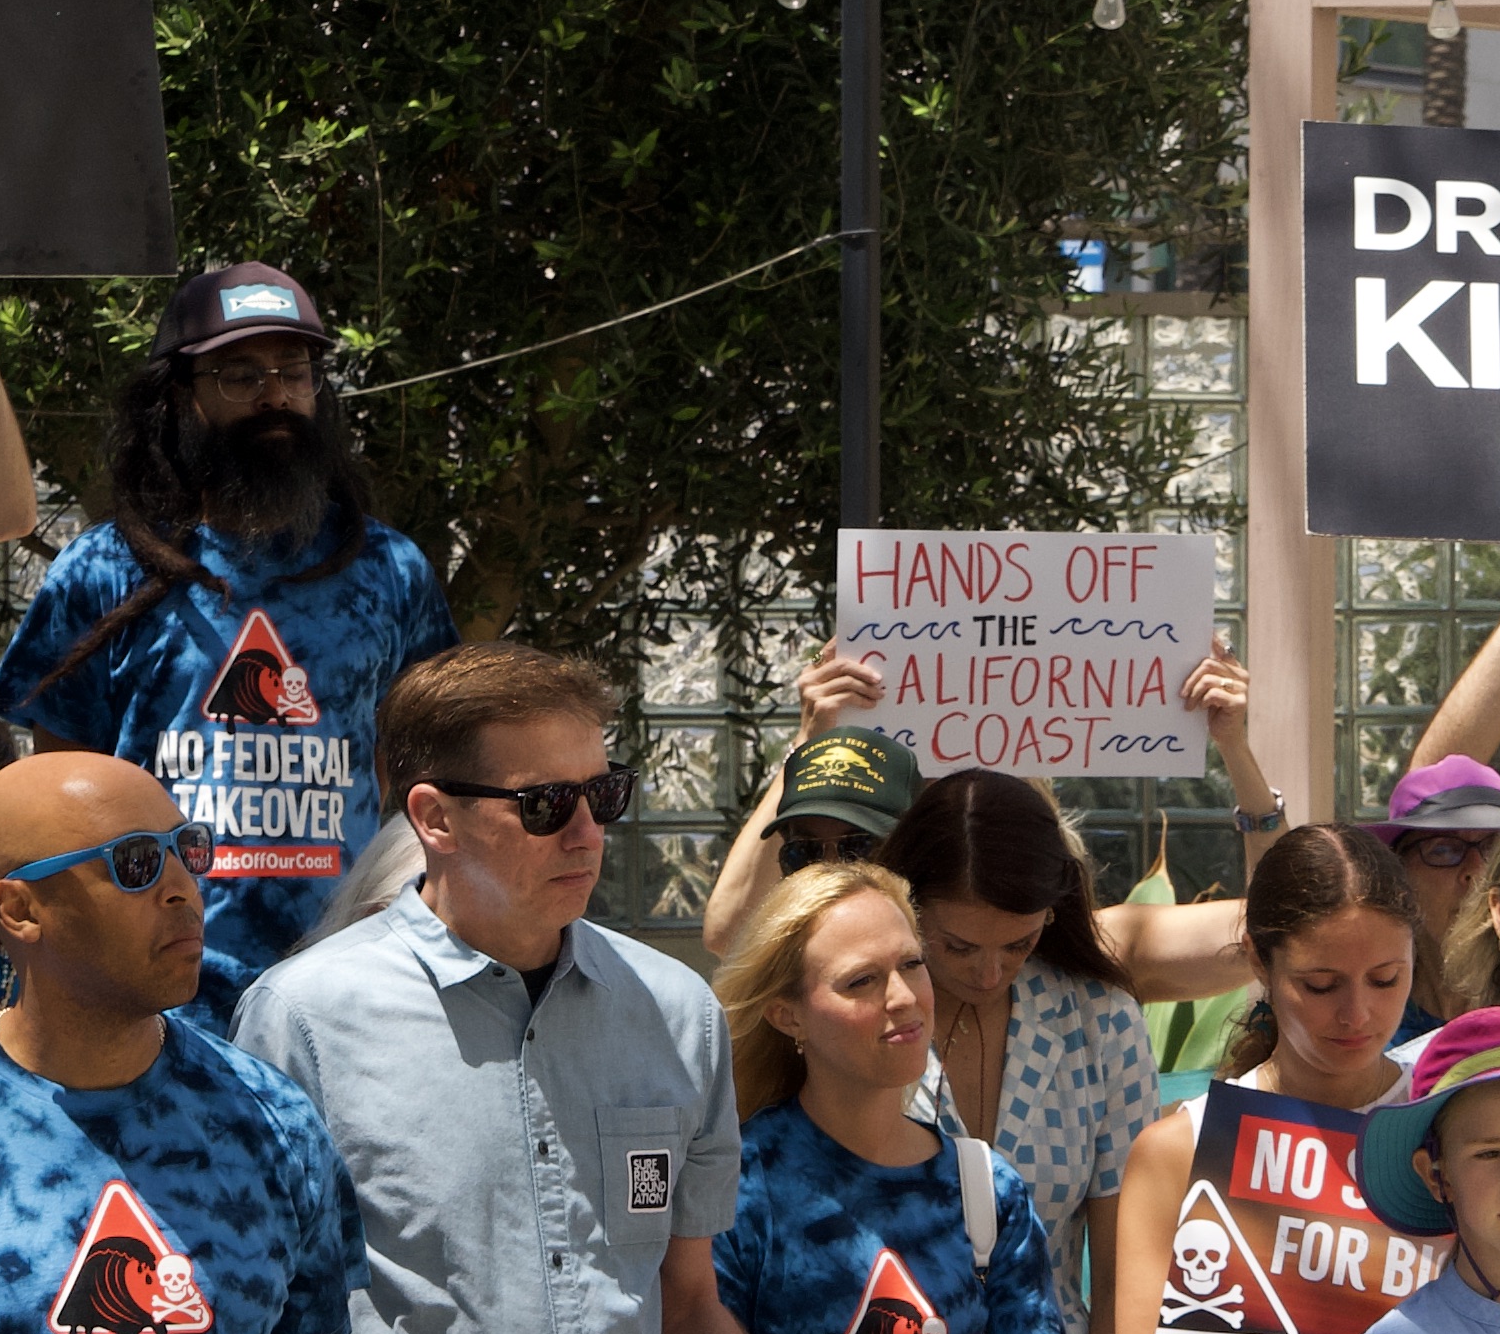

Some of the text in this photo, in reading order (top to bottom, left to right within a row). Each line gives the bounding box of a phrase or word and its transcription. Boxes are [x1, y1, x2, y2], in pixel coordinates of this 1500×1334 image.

[856, 540, 1157, 609] HANDS OFF
[973, 616, 1037, 647] THE
[155, 731, 353, 787] NO FEDERAL
[931, 711, 1111, 768] COAST
[172, 783, 345, 842] TAKEOVER
[212, 851, 333, 871] ndsOffOurCoast
[633, 1158, 658, 1170] SURF
[633, 1168, 660, 1182] RIDER
[1249, 1129, 1327, 1200] NO
[633, 1192, 664, 1205] ATION
[634, 1181, 667, 1194] FOUND
[1270, 1215, 1370, 1292] FOR
